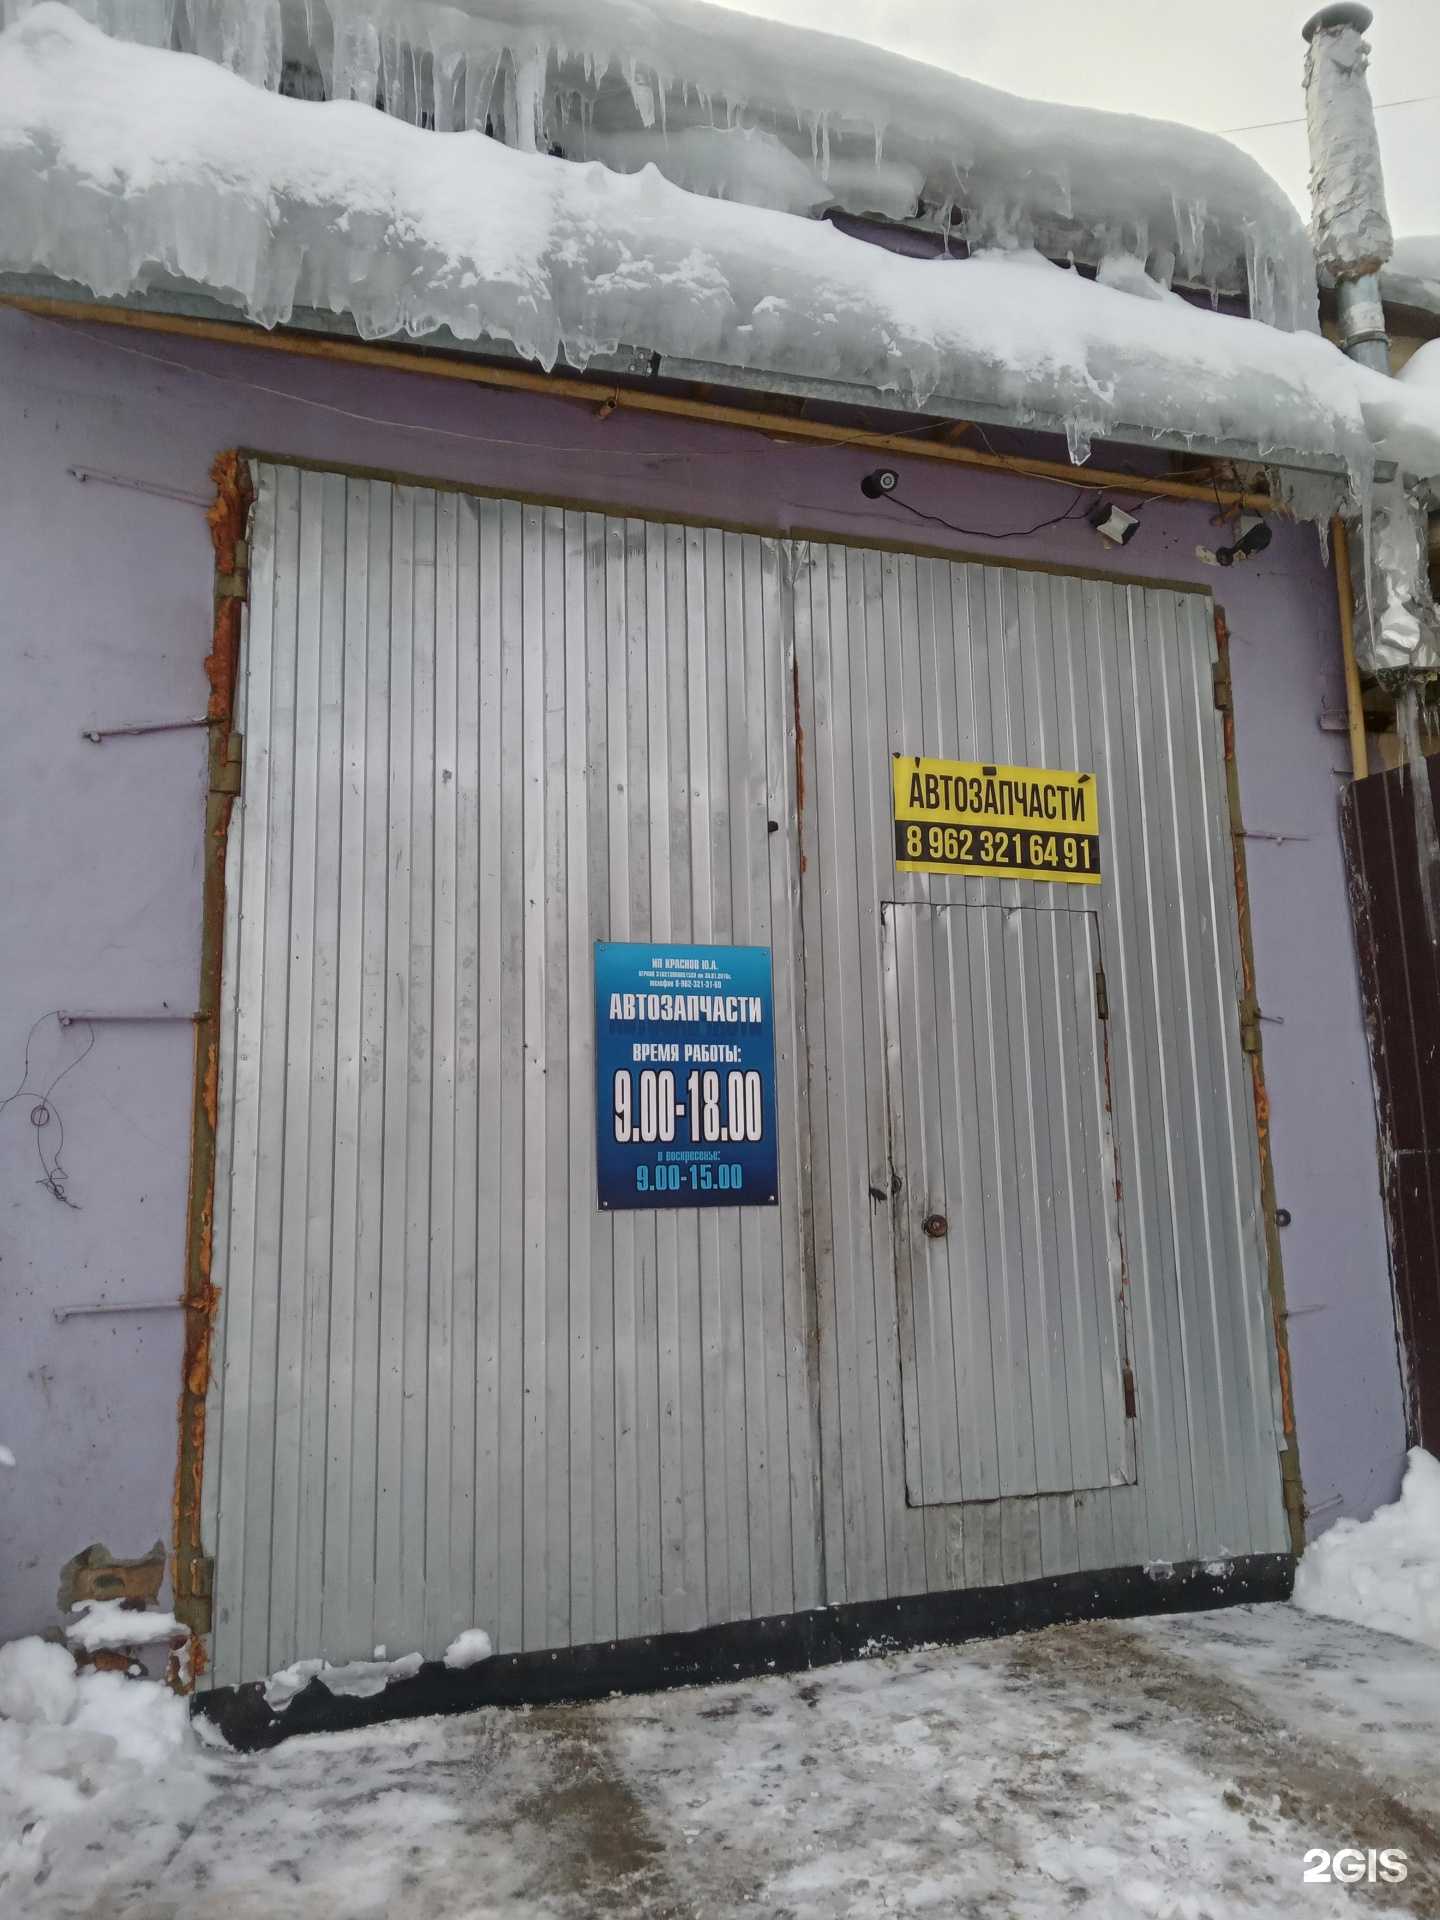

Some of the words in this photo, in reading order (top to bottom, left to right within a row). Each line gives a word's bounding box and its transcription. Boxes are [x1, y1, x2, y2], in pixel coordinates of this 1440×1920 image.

[909, 772, 1085, 822] АВТОЗАПЧАСТИ
[906, 825, 922, 857] 8
[928, 826, 974, 861] 962
[980, 830, 1022, 864] 321
[609, 993, 762, 1023] АВТОЗАПЧАСТИ
[632, 1043, 680, 1062] ВРЕМЯ
[684, 1044, 742, 1063] РАБОТЫ:
[614, 1070, 763, 1143] 9.00-18.00
[636, 1164, 743, 1191] 9.00-15.00
